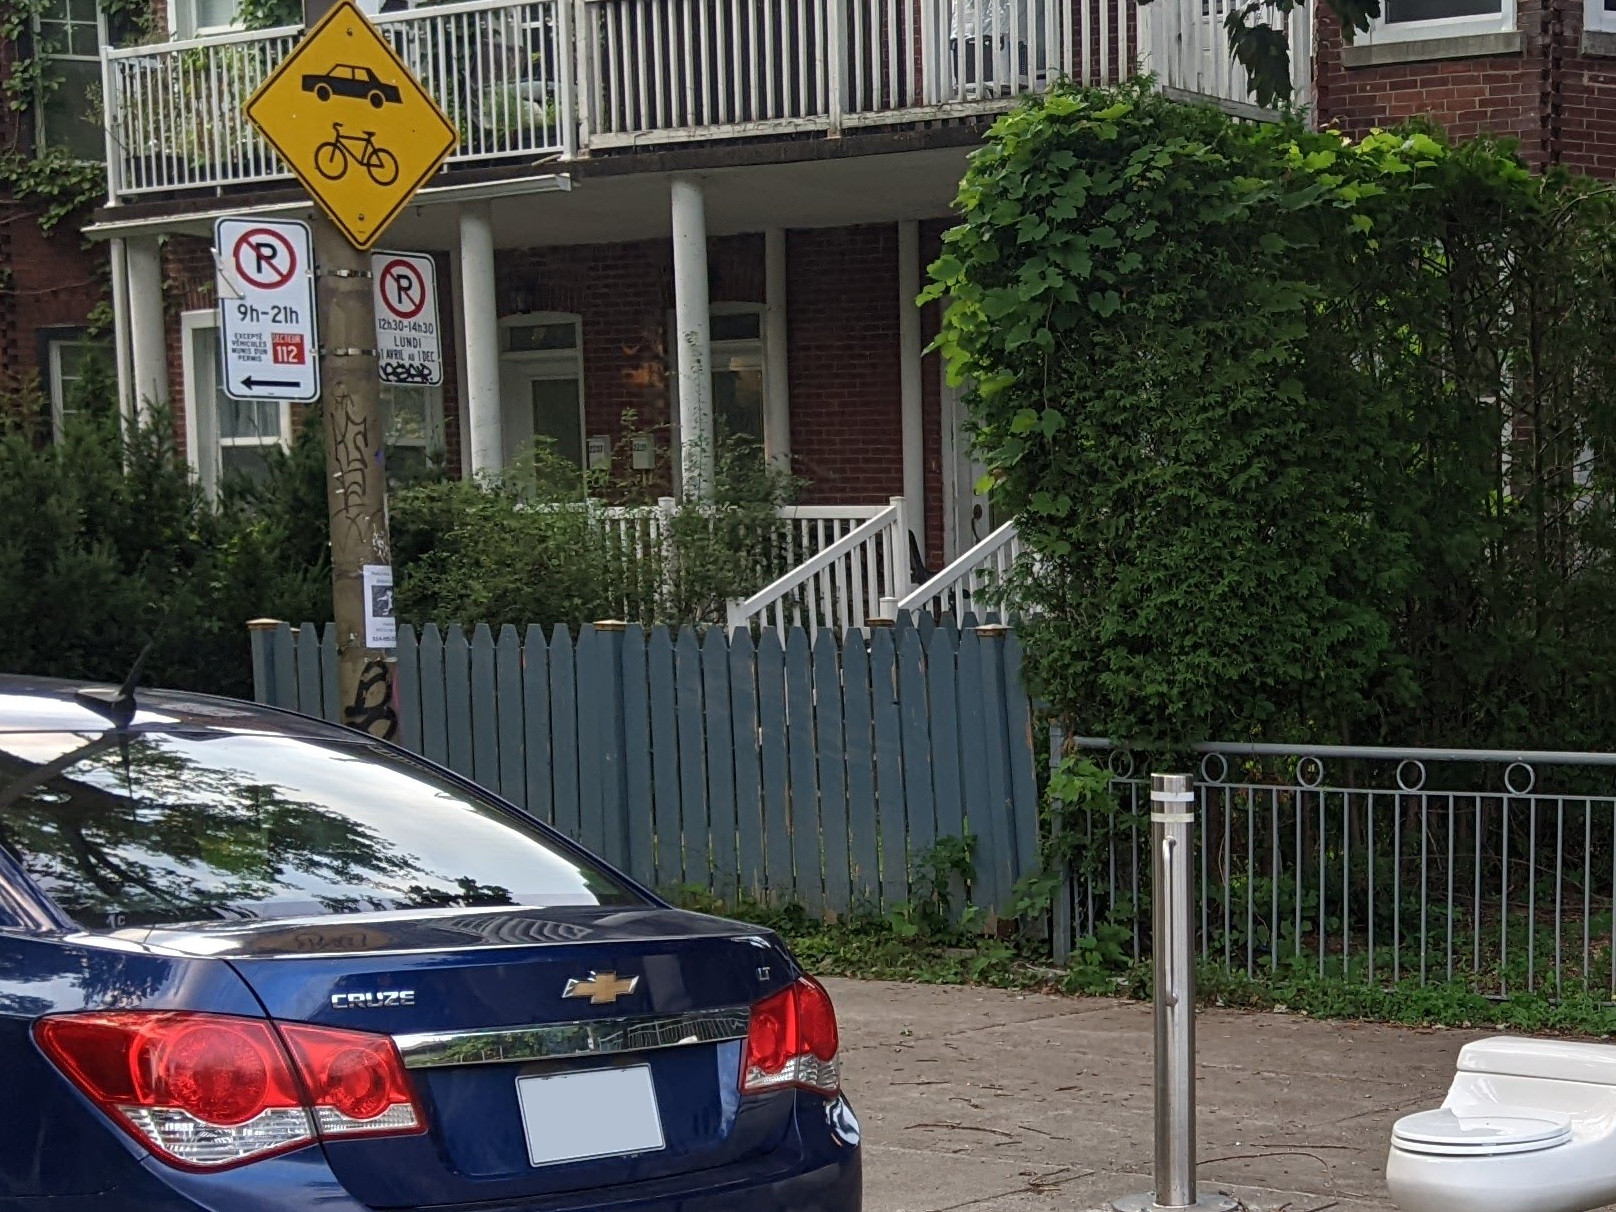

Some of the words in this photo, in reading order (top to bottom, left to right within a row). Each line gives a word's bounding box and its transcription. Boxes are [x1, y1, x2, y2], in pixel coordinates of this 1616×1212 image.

[255, 242, 278, 274] P
[396, 273, 413, 305] P
[237, 303, 300, 324] 9h-21h
[378, 318, 434, 335] 12h30-14h30
[393, 335, 422, 349] LUNDI
[276, 345, 299, 363] 112
[380, 348, 385, 360] 1
[386, 348, 405, 361] AVRIL
[417, 350, 421, 361] 1
[757, 966, 771, 981] LT
[331, 990, 415, 1009] CRUZE
